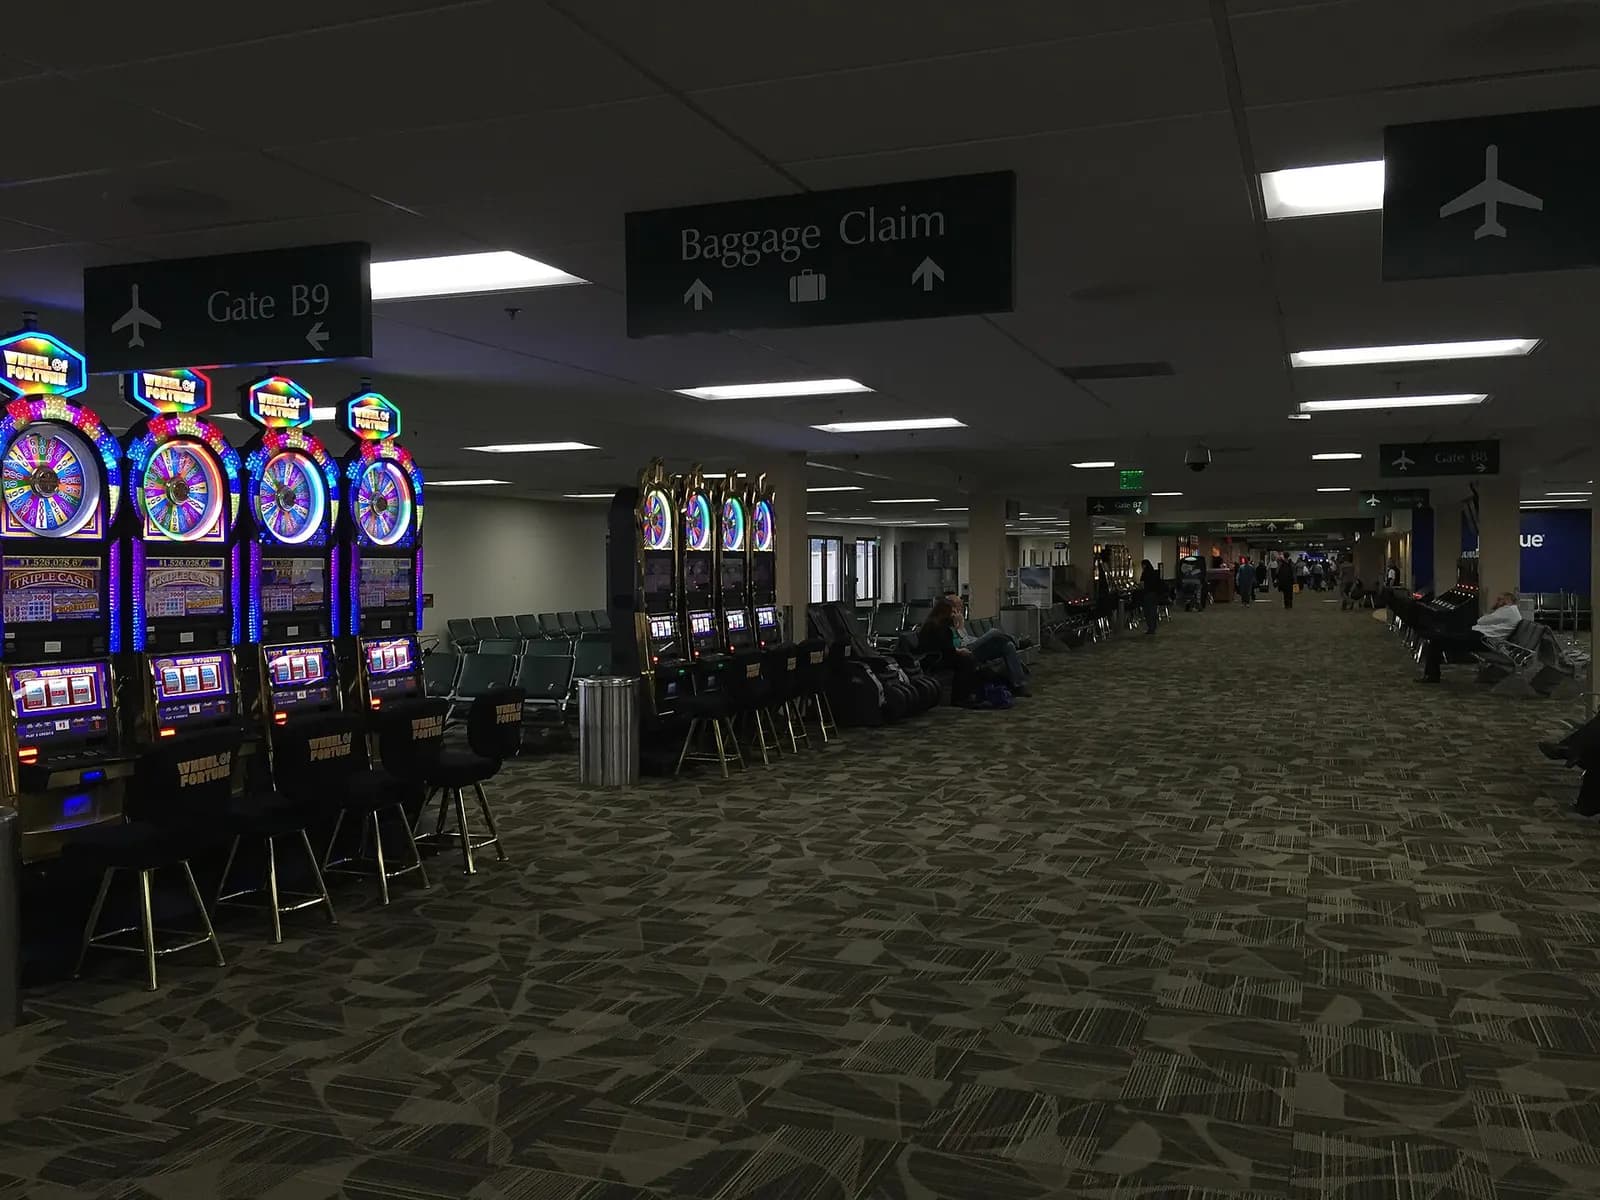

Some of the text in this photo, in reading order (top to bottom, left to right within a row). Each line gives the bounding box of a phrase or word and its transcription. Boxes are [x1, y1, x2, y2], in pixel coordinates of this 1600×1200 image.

[680, 205, 945, 269] Baggage Claim
[207, 283, 330, 322] Gate B9
[3, 350, 52, 371] WHEEL
[7, 364, 68, 386] FORTUNE
[143, 373, 182, 391] WHEEL
[145, 385, 196, 404] FORTUNE
[257, 392, 289, 407] WHEEL
[259, 403, 300, 419] FORTUNE
[1434, 451, 1464, 464] Gate
[14, 572, 89, 588] TRIPLE CASH
[177, 755, 219, 775] WHEEL
[180, 764, 231, 787] FORTUNE
